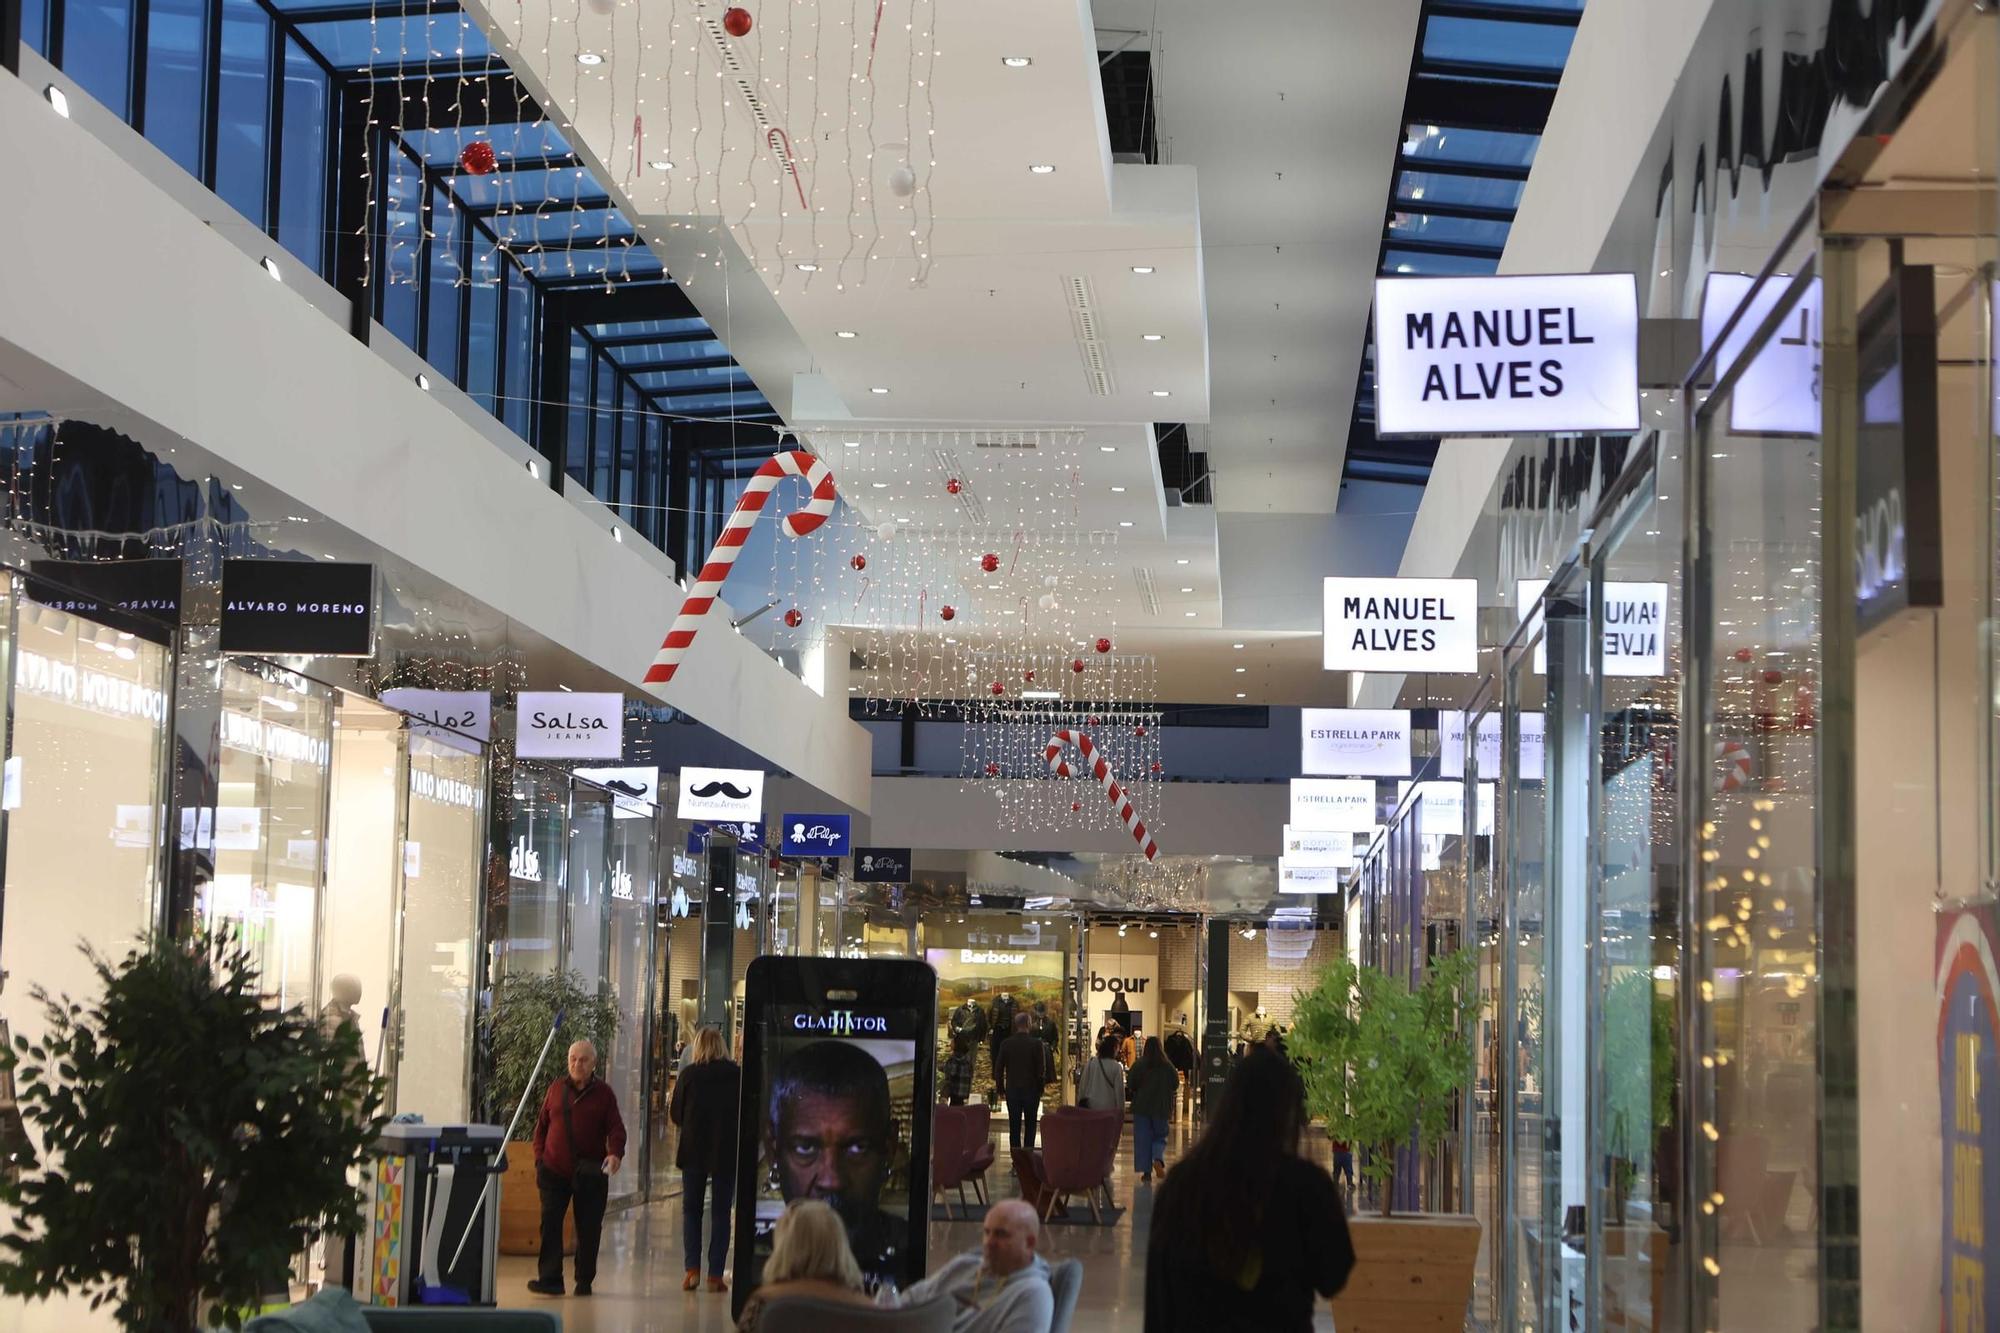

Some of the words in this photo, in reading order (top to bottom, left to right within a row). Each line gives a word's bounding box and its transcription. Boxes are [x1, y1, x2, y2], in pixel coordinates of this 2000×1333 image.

[1406, 307, 1594, 349] MANUEL
[1422, 359, 1563, 401] ALVES
[227, 601, 287, 612] ALVARO
[296, 603, 365, 614] MORENO
[1344, 597, 1455, 620] MANUEL
[1352, 628, 1436, 651] ALVES
[1310, 729, 1369, 740] ESTRELLA
[1371, 730, 1401, 740] PARK
[1297, 795, 1343, 804] ESTRELLA
[1344, 796, 1367, 804] PARK
[960, 949, 1026, 965] Barbour
[1069, 971, 1150, 993] abour
[794, 1013, 887, 1032] GLADIATOR
